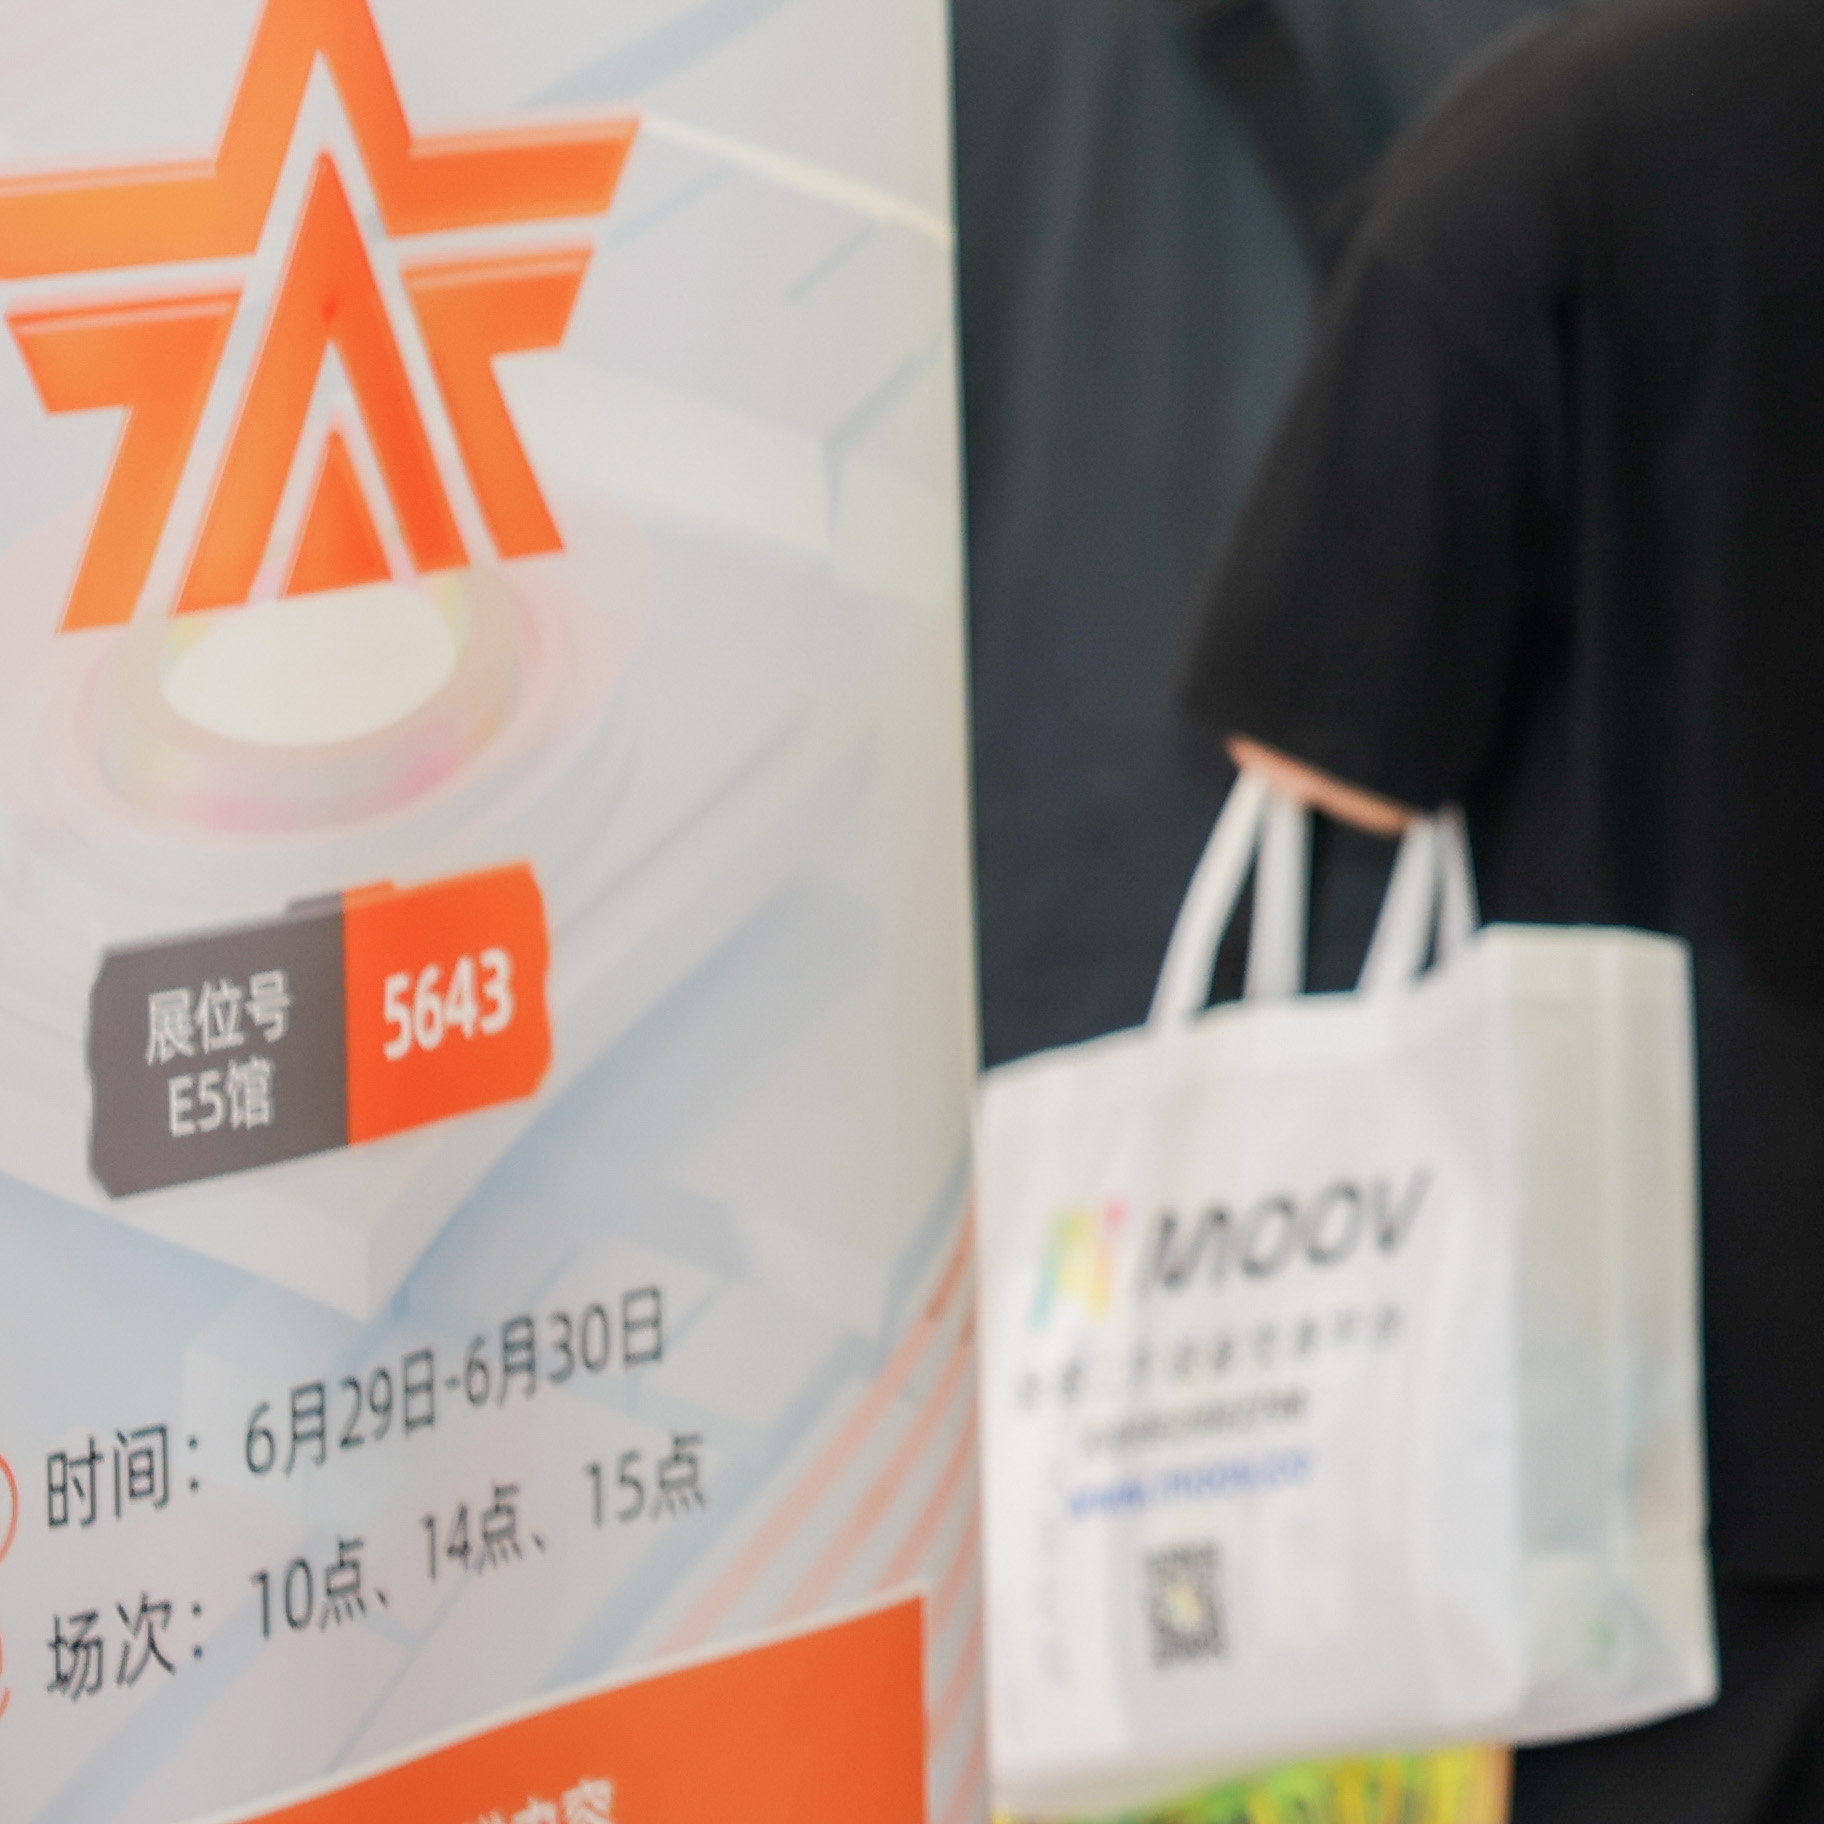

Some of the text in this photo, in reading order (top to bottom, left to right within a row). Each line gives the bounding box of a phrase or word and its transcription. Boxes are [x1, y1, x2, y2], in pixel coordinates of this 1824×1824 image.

[145, 970, 293, 1068] 展位号
[382, 947, 516, 1061] 5643
[168, 1058, 275, 1137] E5馆
